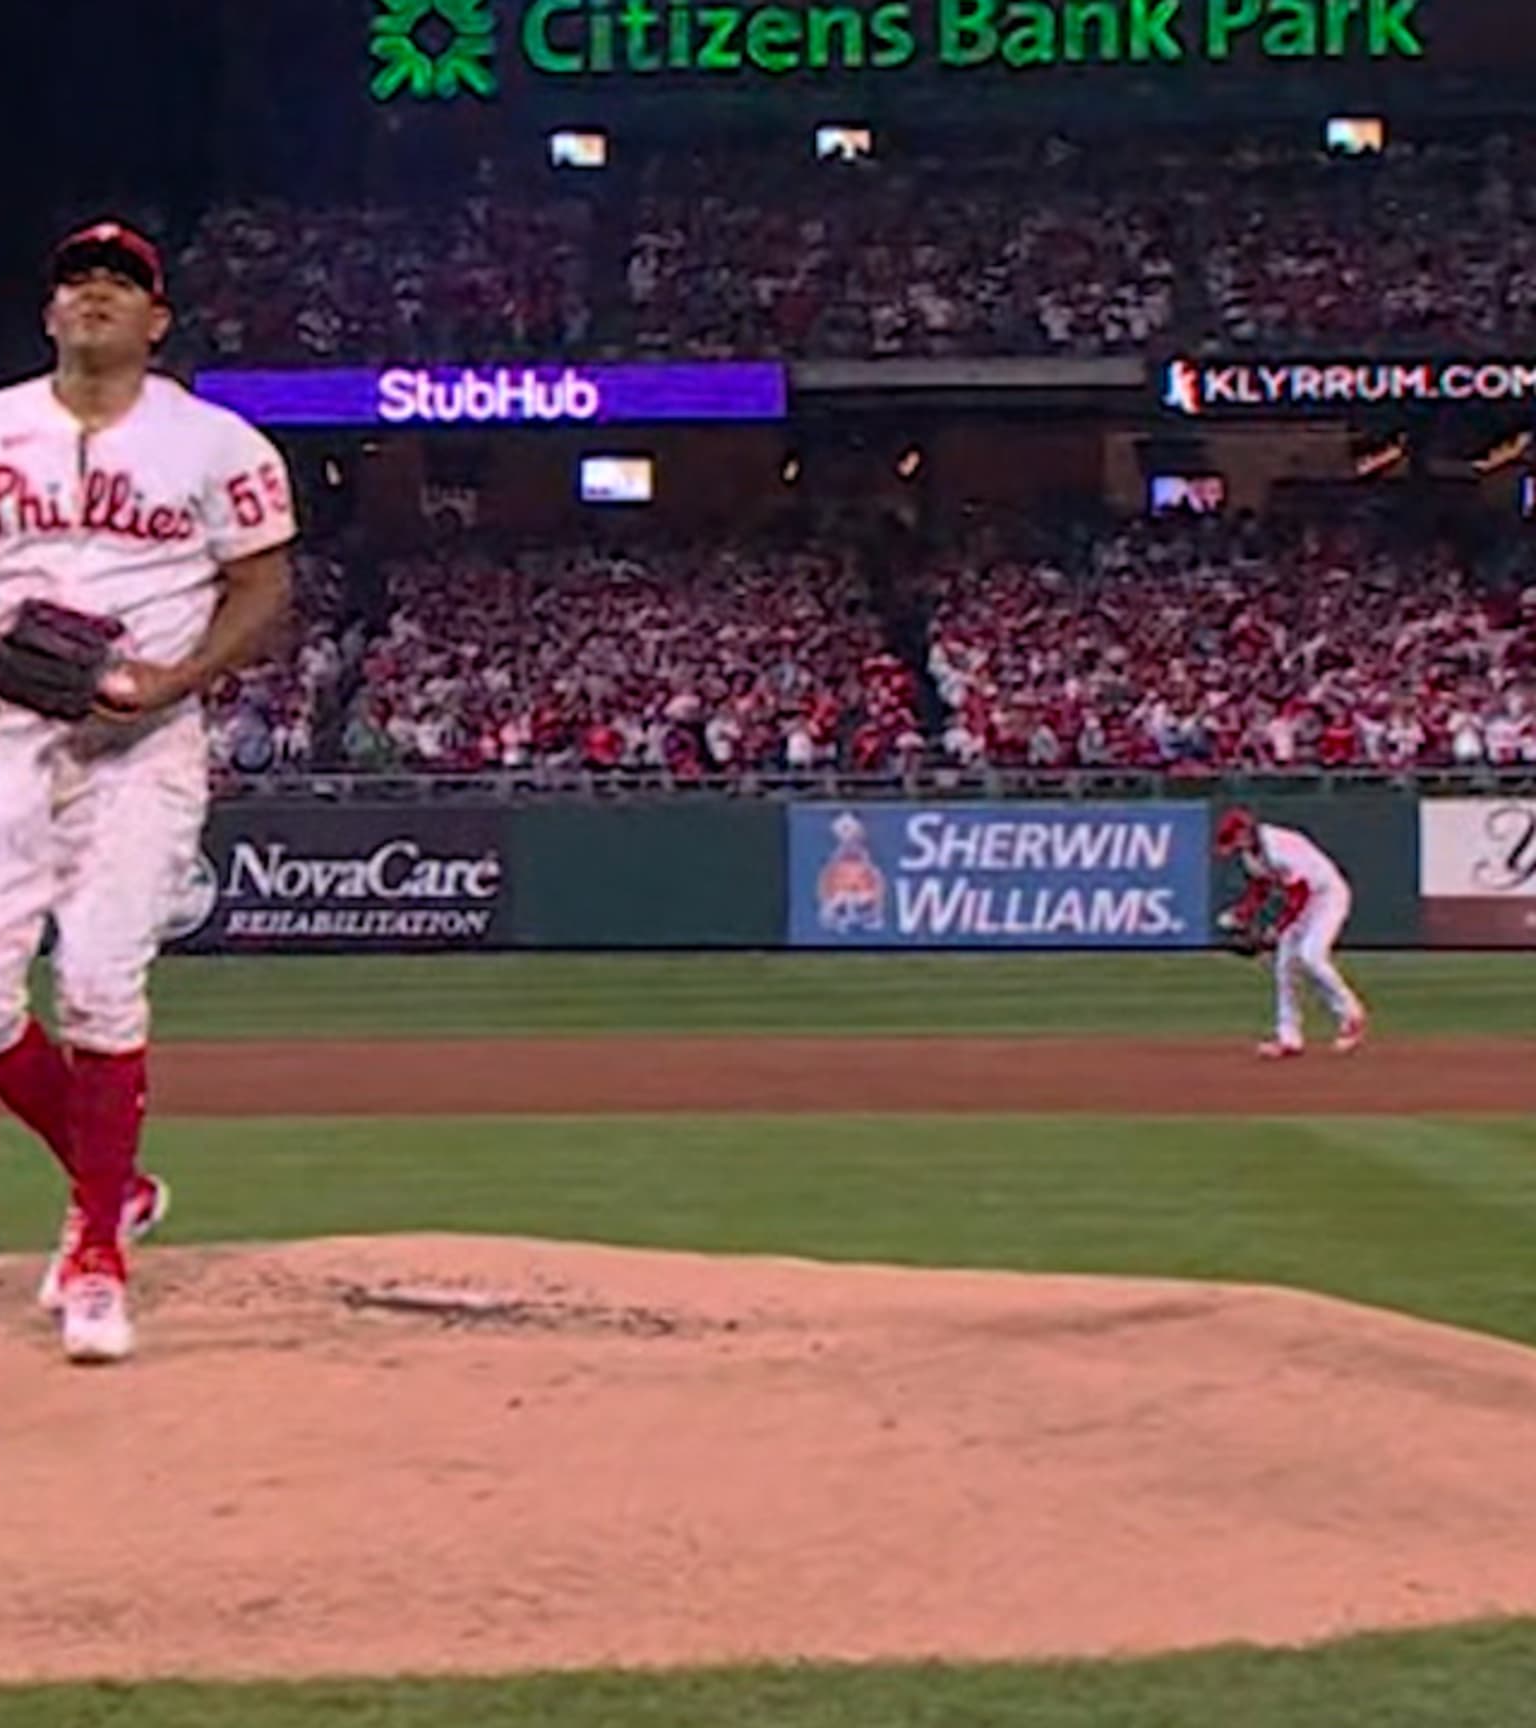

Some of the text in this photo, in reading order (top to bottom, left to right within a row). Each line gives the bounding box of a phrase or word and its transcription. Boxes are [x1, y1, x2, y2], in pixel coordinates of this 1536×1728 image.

[523, 0, 1425, 72] Citizens Bank Park
[378, 367, 599, 422] StubHub
[222, 839, 501, 900] NovaCare
[898, 811, 1173, 871] SHERWIN
[225, 910, 491, 936] REHABILITATION
